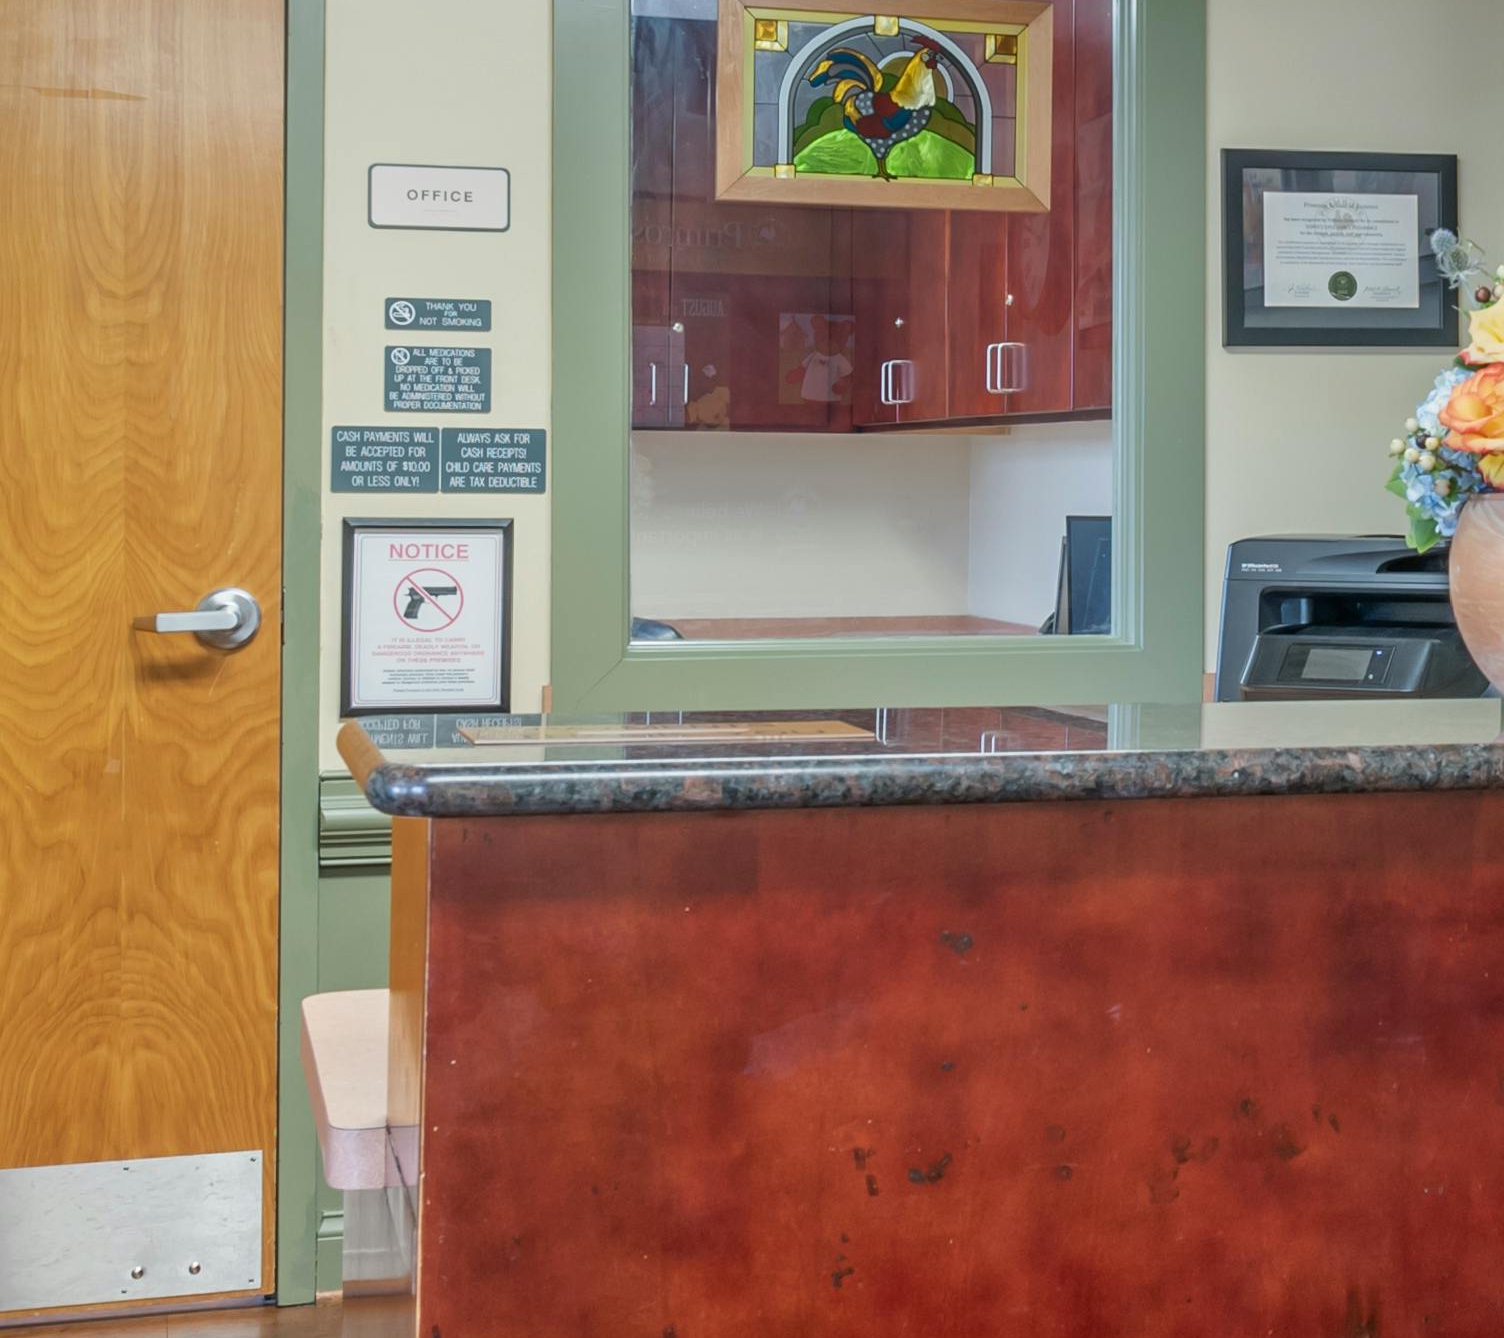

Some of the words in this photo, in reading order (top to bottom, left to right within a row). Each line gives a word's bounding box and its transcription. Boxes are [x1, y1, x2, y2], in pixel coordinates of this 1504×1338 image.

[406, 188, 474, 203] OFFICE
[426, 301, 454, 311] THANK
[458, 302, 477, 312] YOU
[419, 316, 437, 326] NOT
[441, 317, 483, 327] SMOKING
[412, 348, 427, 357] ALL
[429, 348, 476, 358] MEDICATIONS
[424, 357, 439, 366] ARE
[442, 357, 452, 366] TO
[453, 357, 463, 366] BE
[395, 365, 428, 374] DROPPED
[430, 365, 445, 374] OFF
[455, 366, 481, 375] PICKED
[394, 374, 405, 383] UP
[407, 374, 417, 383] AT
[419, 374, 433, 383] THE
[435, 374, 458, 384] FRONT
[399, 383, 411, 392] NO
[413, 383, 456, 392] MEDICATION
[457, 384, 475, 393] WILL
[389, 391, 399, 401] BE
[401, 392, 453, 401] ADMINISTERED
[455, 393, 485, 402] WITHOUT
[393, 401, 422, 410] PROPER
[423, 401, 482, 410] DOCUMENTATION
[337, 430, 361, 442] CASH
[363, 431, 410, 443] PAYMENTS
[413, 432, 434, 444] WILL
[457, 432, 491, 445] ALWAYS
[494, 433, 511, 444] ASK
[513, 433, 530, 445] FOR
[345, 446, 357, 457] BE
[360, 446, 405, 458] ACCEPTED
[408, 446, 426, 457] FOR
[460, 447, 484, 458] CASH
[486, 447, 527, 459] RECEIPTS!
[340, 460, 384, 472] AMOUNTS
[386, 461, 398, 472] OF
[402, 461, 431, 473] $10.00
[445, 461, 470, 473] CHILD
[473, 462, 494, 473] CARE
[497, 462, 542, 474] PAYMENTS
[351, 475, 364, 487] OR
[367, 475, 391, 487] LESS
[394, 475, 420, 487] ONLY!
[449, 476, 466, 487] ARE
[469, 476, 485, 488] TAX
[488, 476, 537, 489] DEDUCTIBLE
[389, 543, 470, 559] NOTICE
